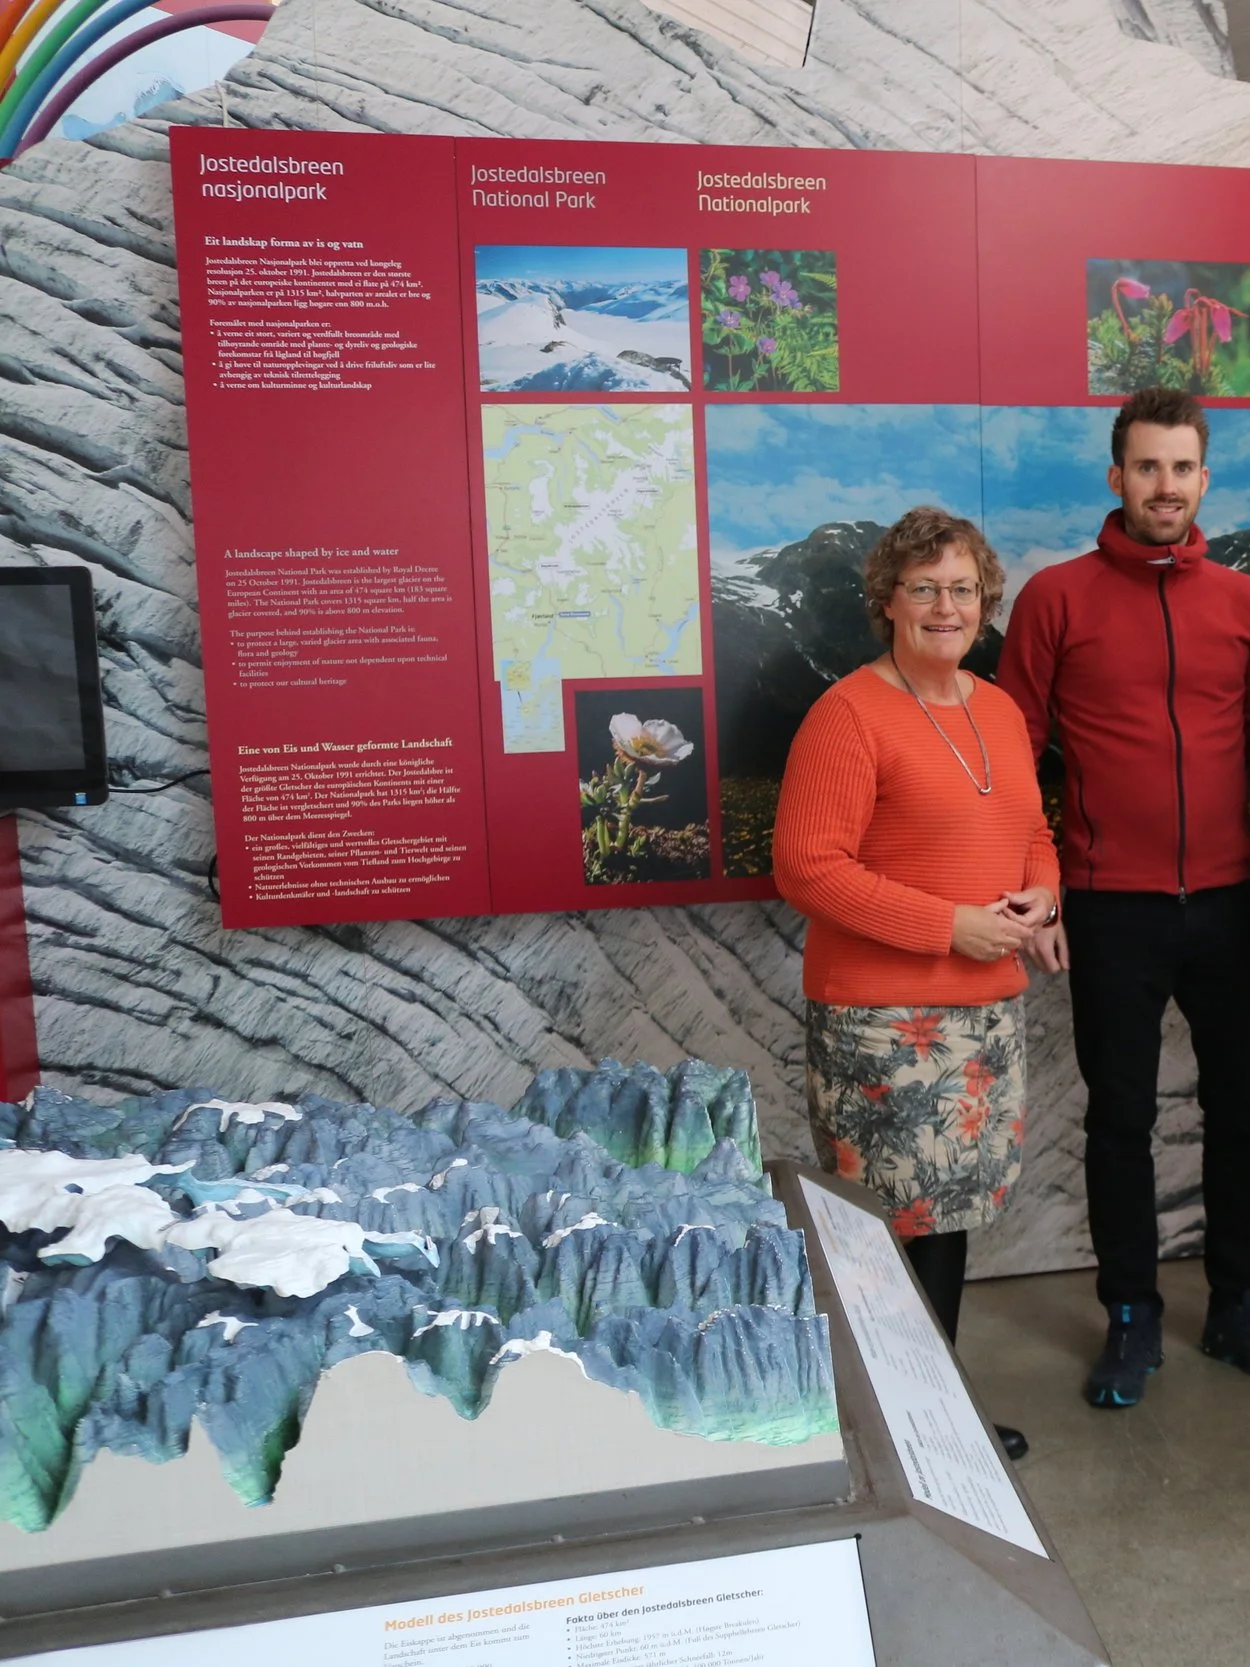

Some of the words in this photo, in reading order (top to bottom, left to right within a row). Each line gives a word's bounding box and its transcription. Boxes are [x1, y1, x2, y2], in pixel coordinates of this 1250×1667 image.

[200, 154, 344, 175] Jostedalsbreen
[471, 166, 605, 184] Jostedalsbreen
[698, 171, 826, 191] Jostedalsbreen
[202, 181, 326, 202] nasjonalpark
[473, 189, 549, 208] National
[556, 191, 596, 208] Park
[699, 195, 810, 216] Nationalpark
[205, 236, 219, 245] Eit
[222, 236, 267, 249] landskap
[270, 237, 299, 247] forma
[316, 238, 324, 248] is
[327, 241, 339, 250] og
[205, 257, 257, 266] Jostedalsbreen
[260, 258, 307, 268] Nasjonalpark
[369, 260, 401, 269] kongeleg
[206, 268, 243, 277] resolusjon
[311, 269, 361, 278] Jostedalsbreen
[229, 278, 238, 287] på
[253, 278, 291, 287] europeiske
[380, 279, 388, 288] på
[207, 288, 264, 298] Nasjonalparken
[275, 289, 284, 298] på
[325, 290, 363, 299] halvparten
[238, 299, 291, 308] nasjonalparken
[294, 299, 307, 308] ligg
[224, 549, 231, 557] A
[234, 549, 281, 559] landscape
[285, 548, 318, 558] shaped
[321, 548, 332, 558] by
[336, 548, 349, 556] ice
[352, 547, 369, 556] and
[238, 745, 259, 754] Eine
[283, 744, 297, 752] Eis
[300, 743, 319, 752] und
[321, 743, 353, 751] Wasser
[357, 741, 398, 752] geformte
[402, 738, 452, 748] Landschaft
[239, 764, 288, 774] Jostedalsbreen
[291, 761, 335, 771] Nationalpark
[399, 758, 434, 768] königliche
[385, 1615, 433, 1631] Modell
[438, 1613, 464, 1624] des
[467, 1596, 574, 1622] Jostedalsbreen
[579, 1586, 644, 1604] Gletscher
[566, 1615, 594, 1624] Fakta
[597, 1610, 619, 1620] über
[622, 1608, 640, 1617] den
[642, 1597, 714, 1615] Jostedalsbreen
[716, 1588, 764, 1602] Gletscher:
[448, 1629, 499, 1642] abgenommen
[384, 1647, 426, 1660] Landschaft
